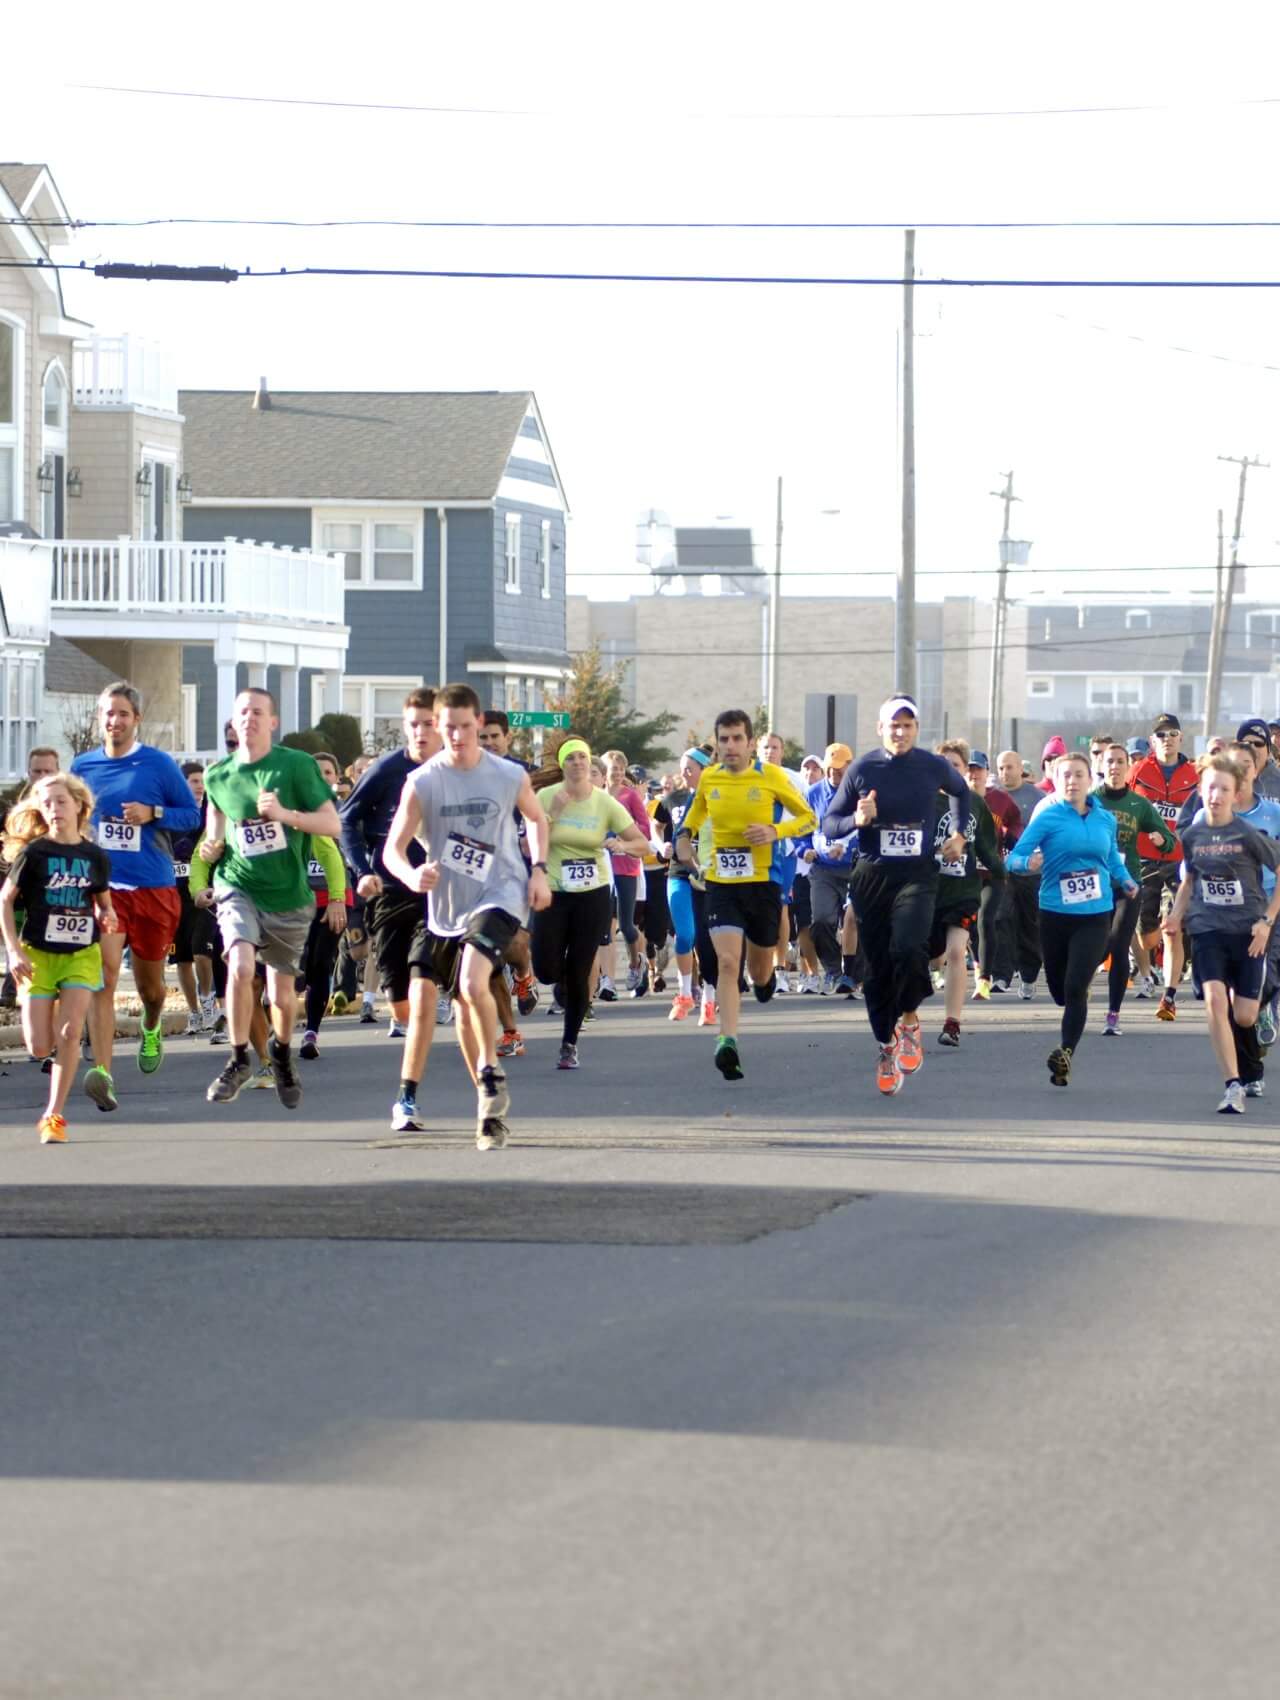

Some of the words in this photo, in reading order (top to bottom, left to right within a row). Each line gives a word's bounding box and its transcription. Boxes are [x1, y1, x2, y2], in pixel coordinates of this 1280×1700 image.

[512, 713, 524, 725] 27
[553, 714, 563, 727] ST
[1157, 806, 1176, 818] 710
[105, 824, 134, 840] 940
[244, 824, 276, 844] 845
[888, 832, 916, 846] 746
[451, 844, 486, 869] 844
[720, 855, 747, 868] 932
[47, 857, 91, 878] PLAY
[567, 866, 594, 880] 733
[45, 872, 77, 889] like
[1067, 877, 1096, 893] 934
[1207, 882, 1236, 896] 865
[45, 887, 87, 908] GIRL
[56, 917, 89, 933] 902
